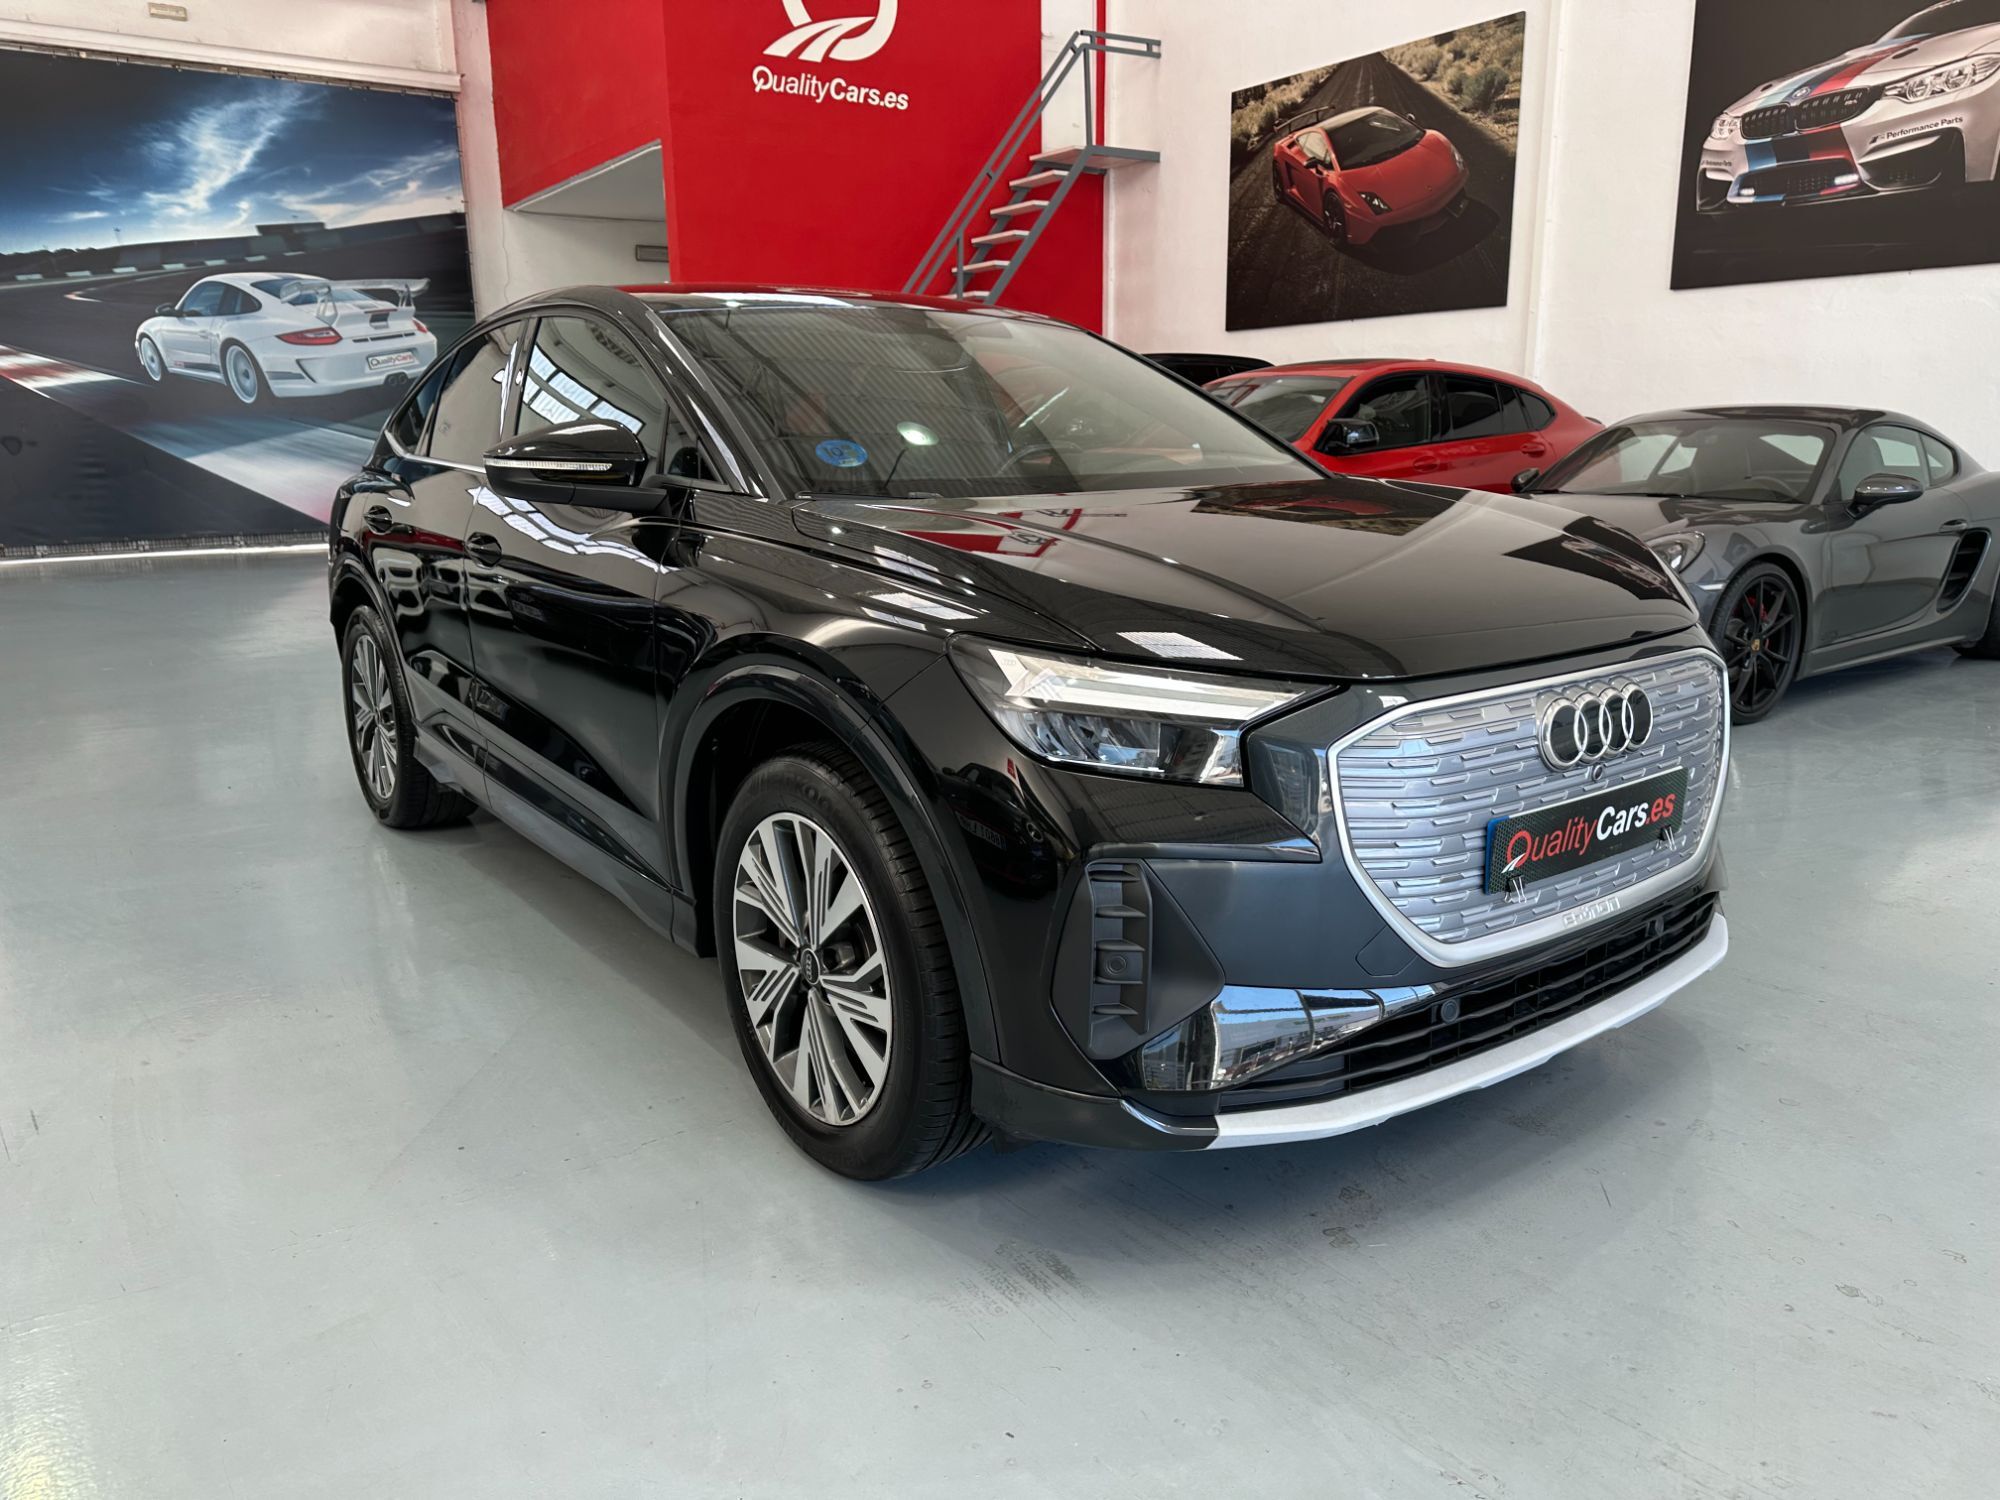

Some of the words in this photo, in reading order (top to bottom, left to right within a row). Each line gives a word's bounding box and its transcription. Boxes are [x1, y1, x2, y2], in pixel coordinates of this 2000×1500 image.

[752, 65, 909, 110] QualityCars.es
[1886, 122, 1939, 140] Performance
[1940, 116, 1964, 127] Parts
[1501, 793, 1676, 874] QualityCars.es
